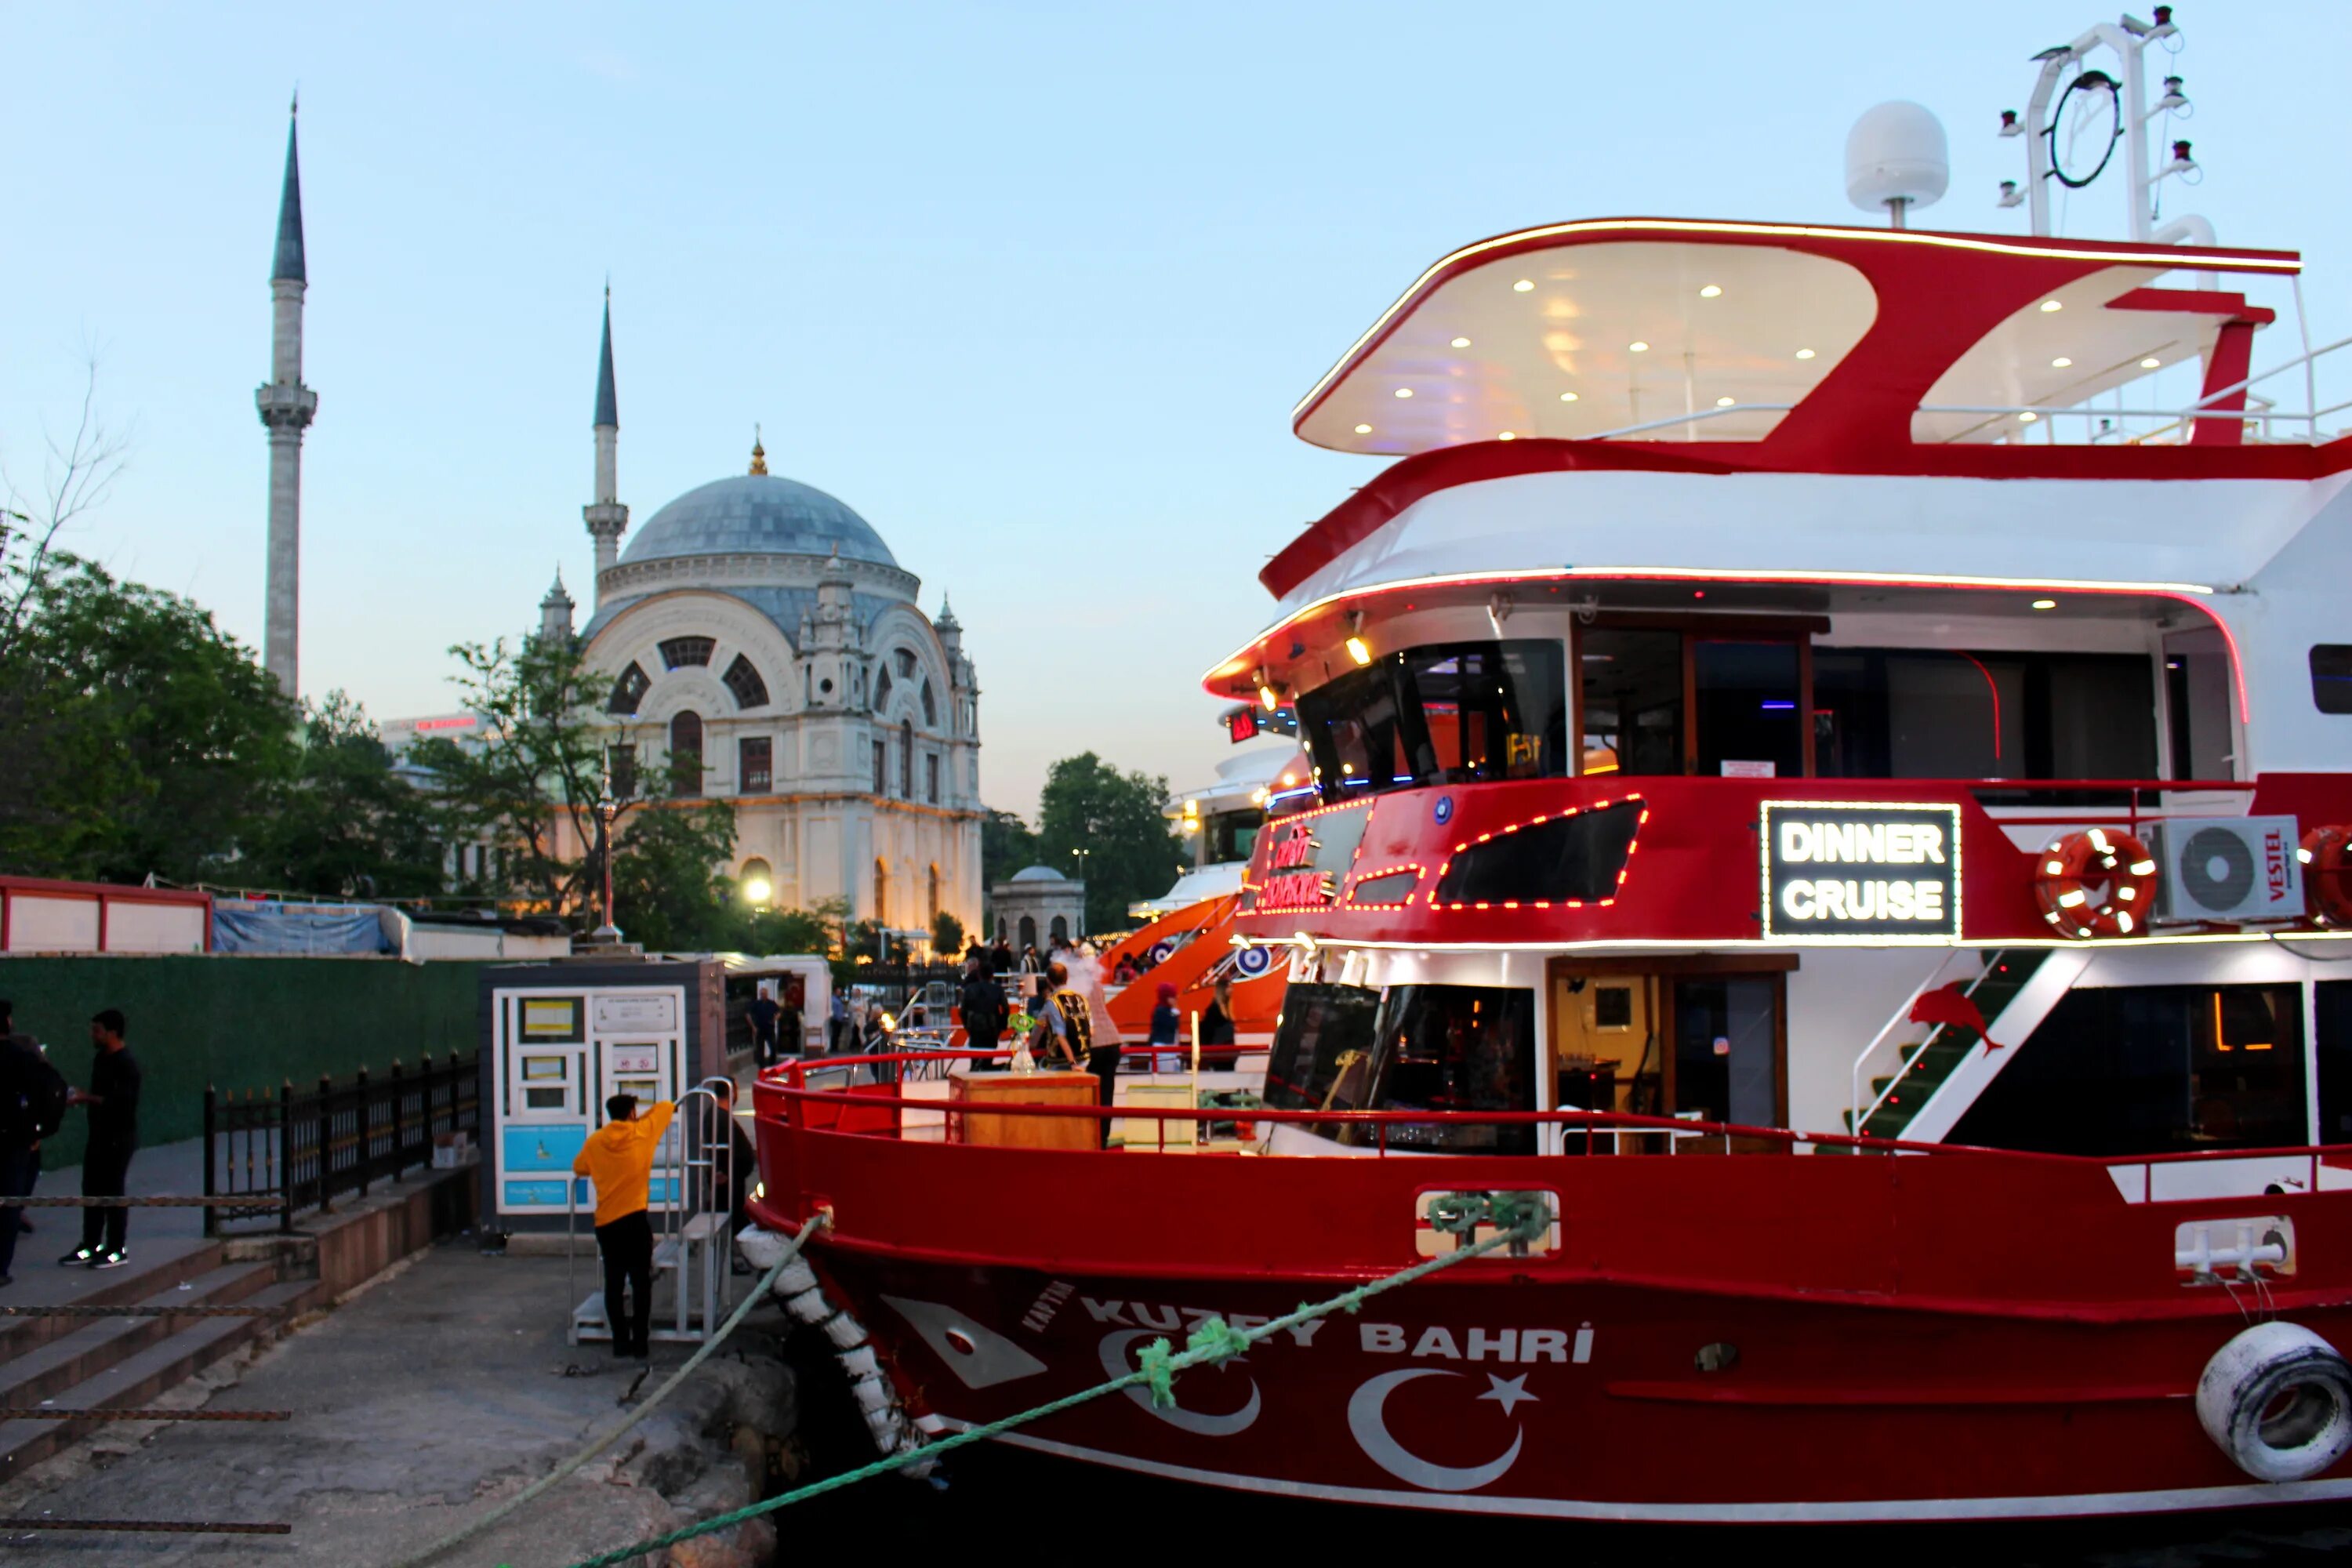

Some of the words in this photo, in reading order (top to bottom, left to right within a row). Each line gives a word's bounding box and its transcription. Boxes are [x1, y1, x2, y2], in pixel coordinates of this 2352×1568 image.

[1780, 822, 1945, 863] DINNER
[2264, 828, 2285, 902] VESTEL
[1782, 880, 1944, 920] CRUISE
[1022, 1280, 1075, 1333] KAPTAN
[1359, 1321, 1595, 1363] BAHRİ
